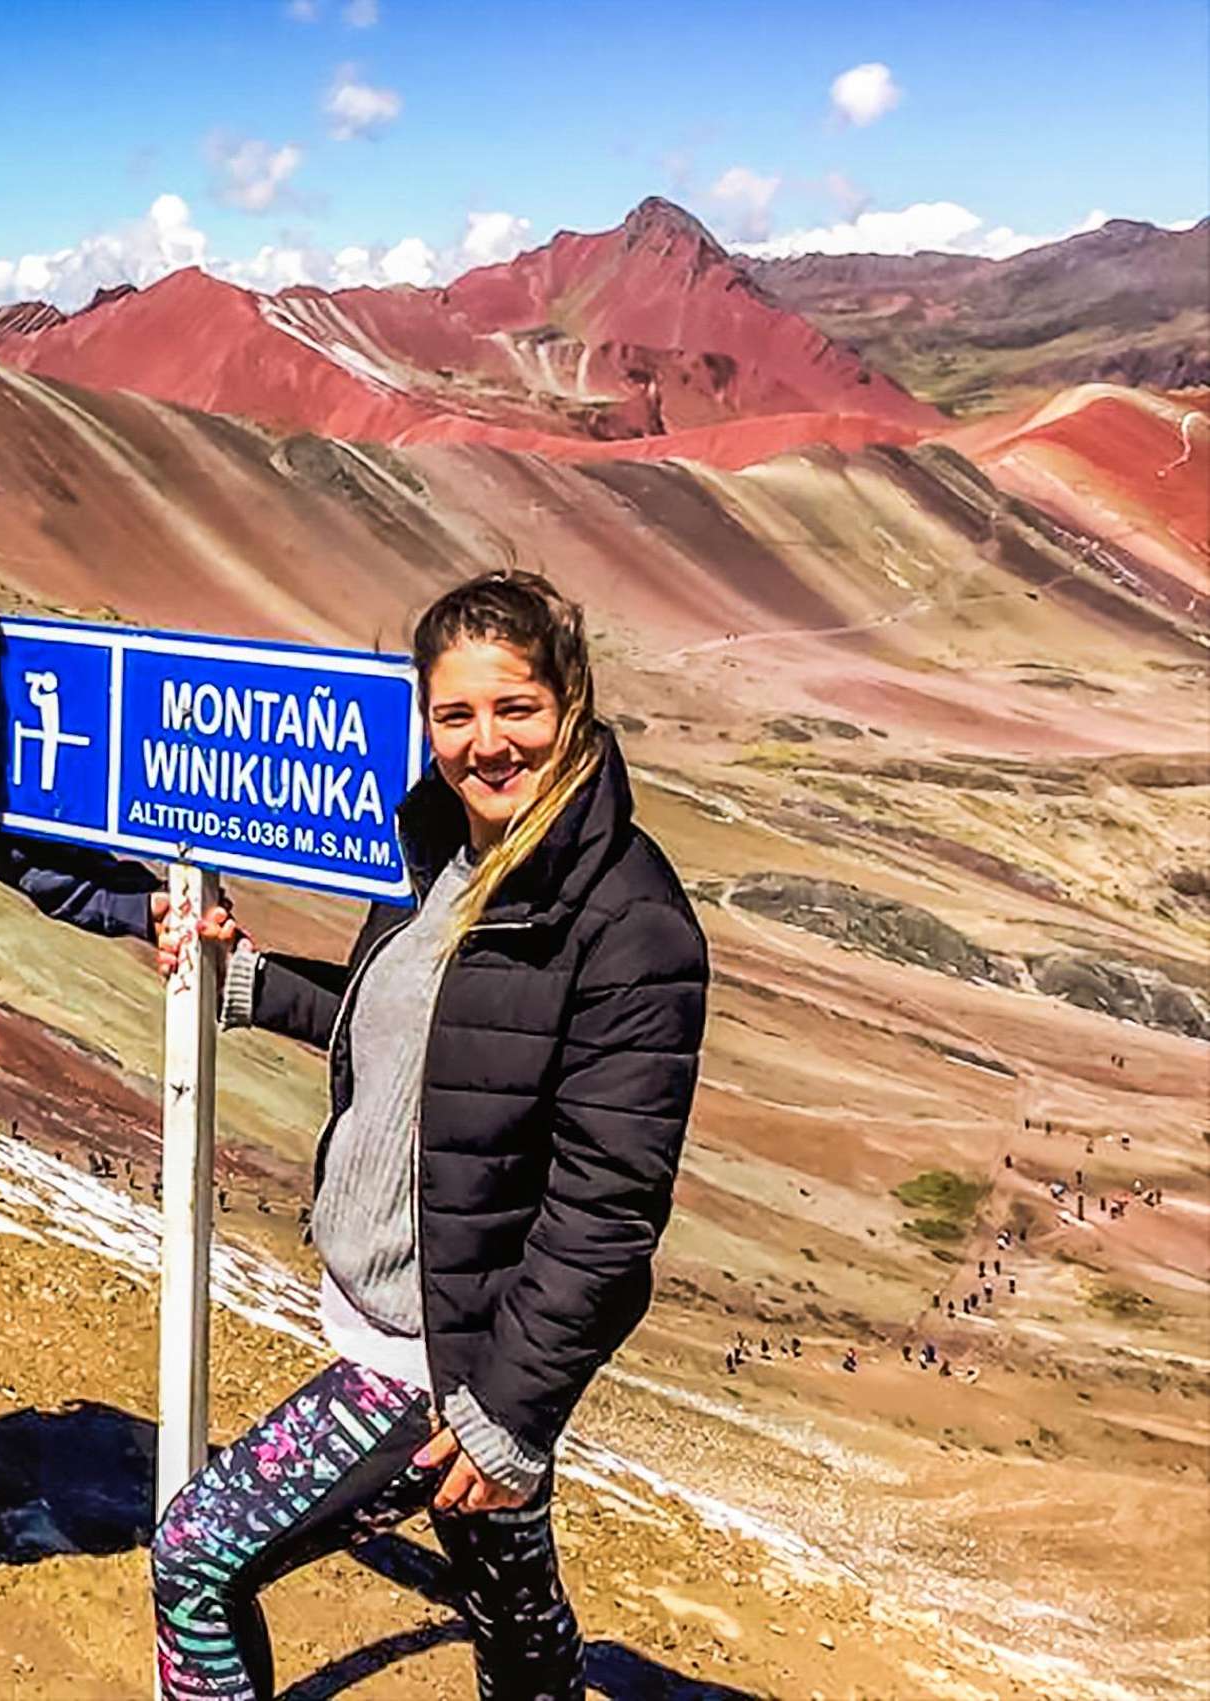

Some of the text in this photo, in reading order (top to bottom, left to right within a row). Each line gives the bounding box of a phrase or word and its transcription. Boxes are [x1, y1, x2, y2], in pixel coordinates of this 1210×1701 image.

[161, 679, 368, 757] MONTAÑA
[142, 738, 384, 825] WINIKUNKA
[293, 827, 398, 868] M.S.N.M.
